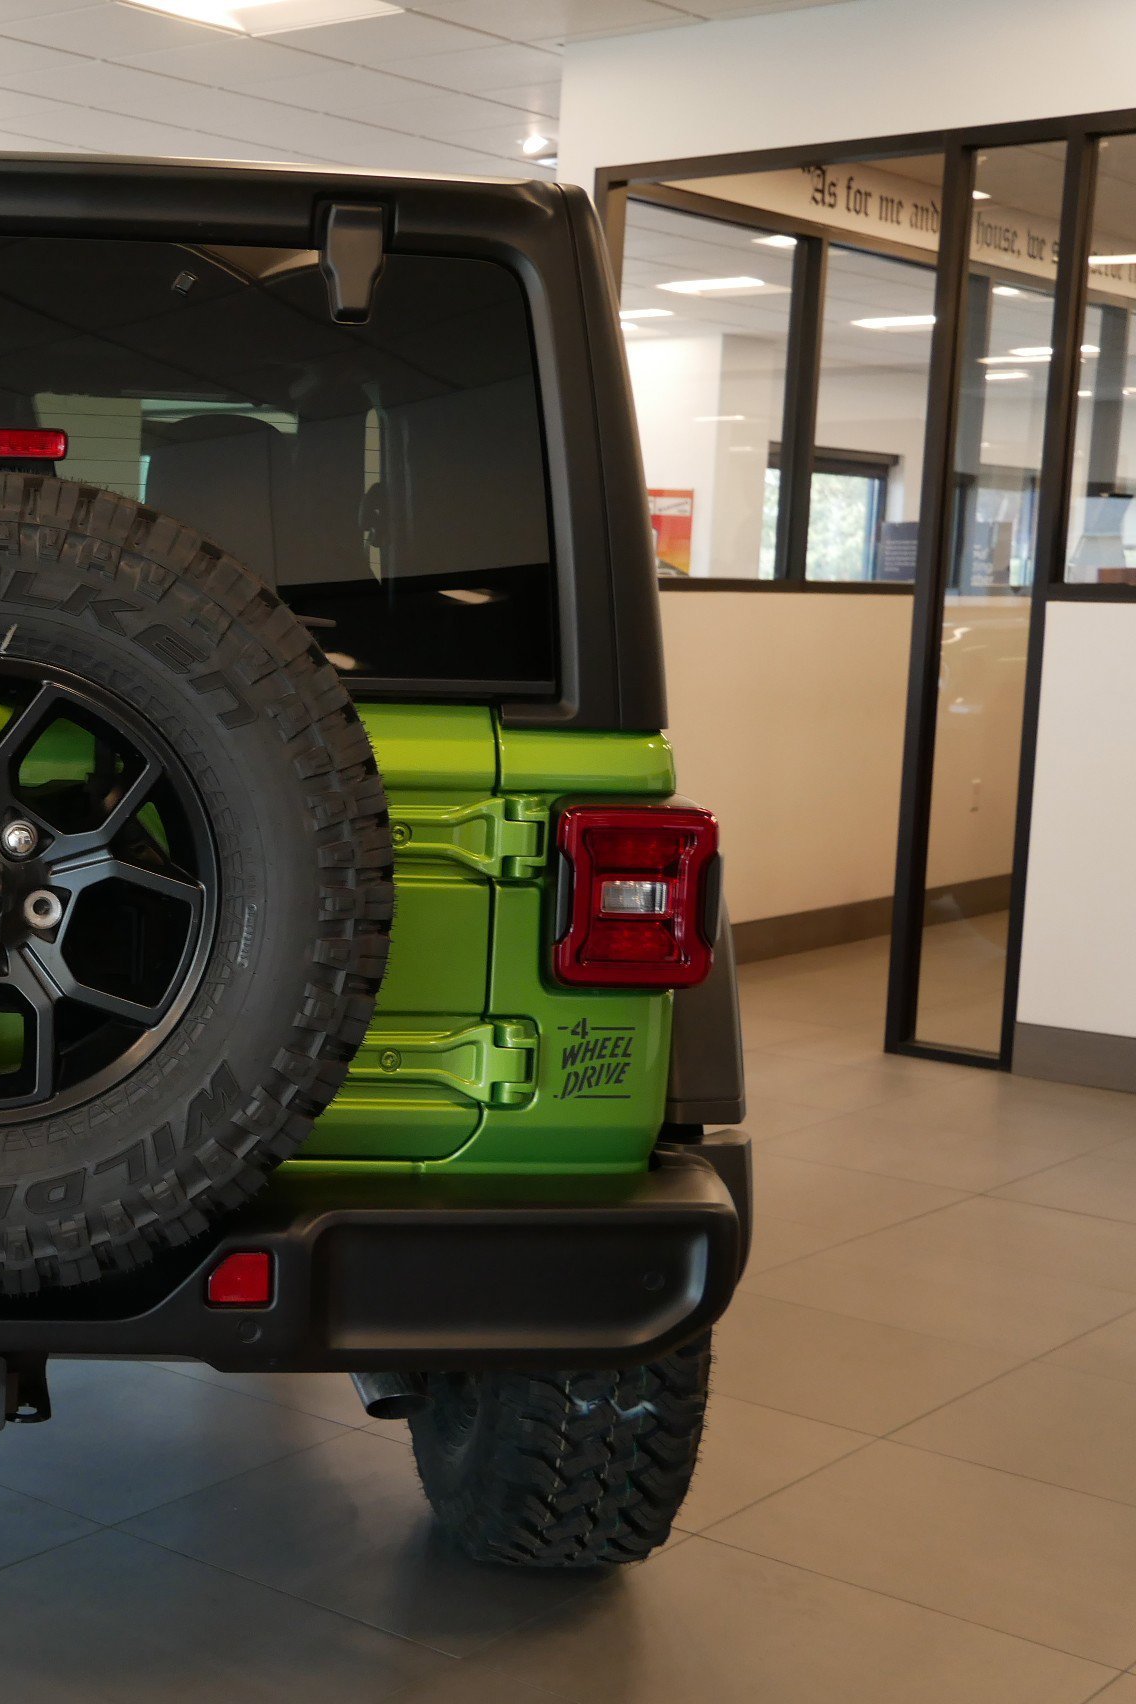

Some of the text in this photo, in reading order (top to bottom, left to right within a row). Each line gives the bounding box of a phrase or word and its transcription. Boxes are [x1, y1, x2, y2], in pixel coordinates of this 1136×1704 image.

[846, 176, 872, 217] for
[879, 195, 904, 225] me
[910, 201, 940, 233] and
[976, 212, 1022, 257] house,
[1027, 231, 1046, 261] we
[570, 1017, 589, 1040] 4
[561, 1036, 634, 1071] WHEEL
[559, 1062, 632, 1100] DRIVE
